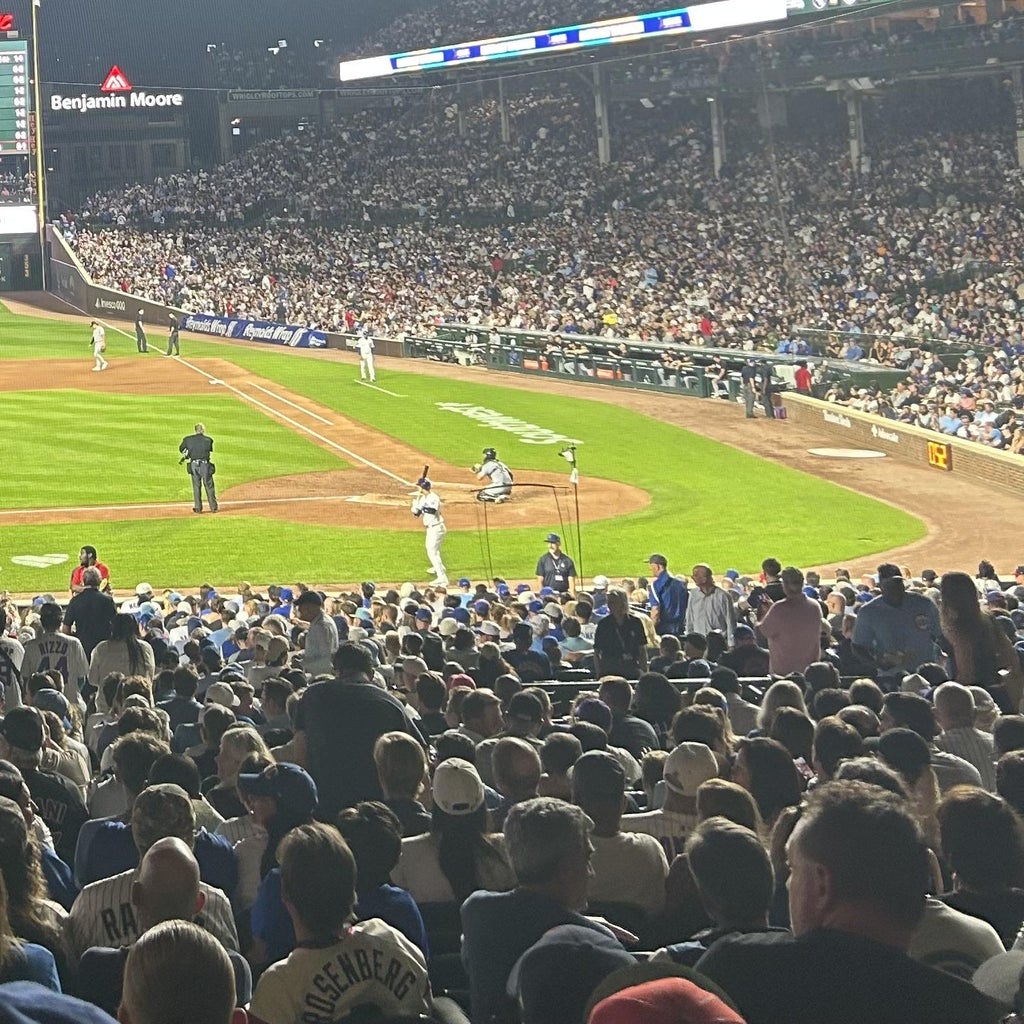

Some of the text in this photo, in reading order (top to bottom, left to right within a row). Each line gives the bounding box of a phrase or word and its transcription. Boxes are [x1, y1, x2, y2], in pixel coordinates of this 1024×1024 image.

[50, 92, 184, 112] Benjamin Moore
[38, 640, 68, 655] RIZZO
